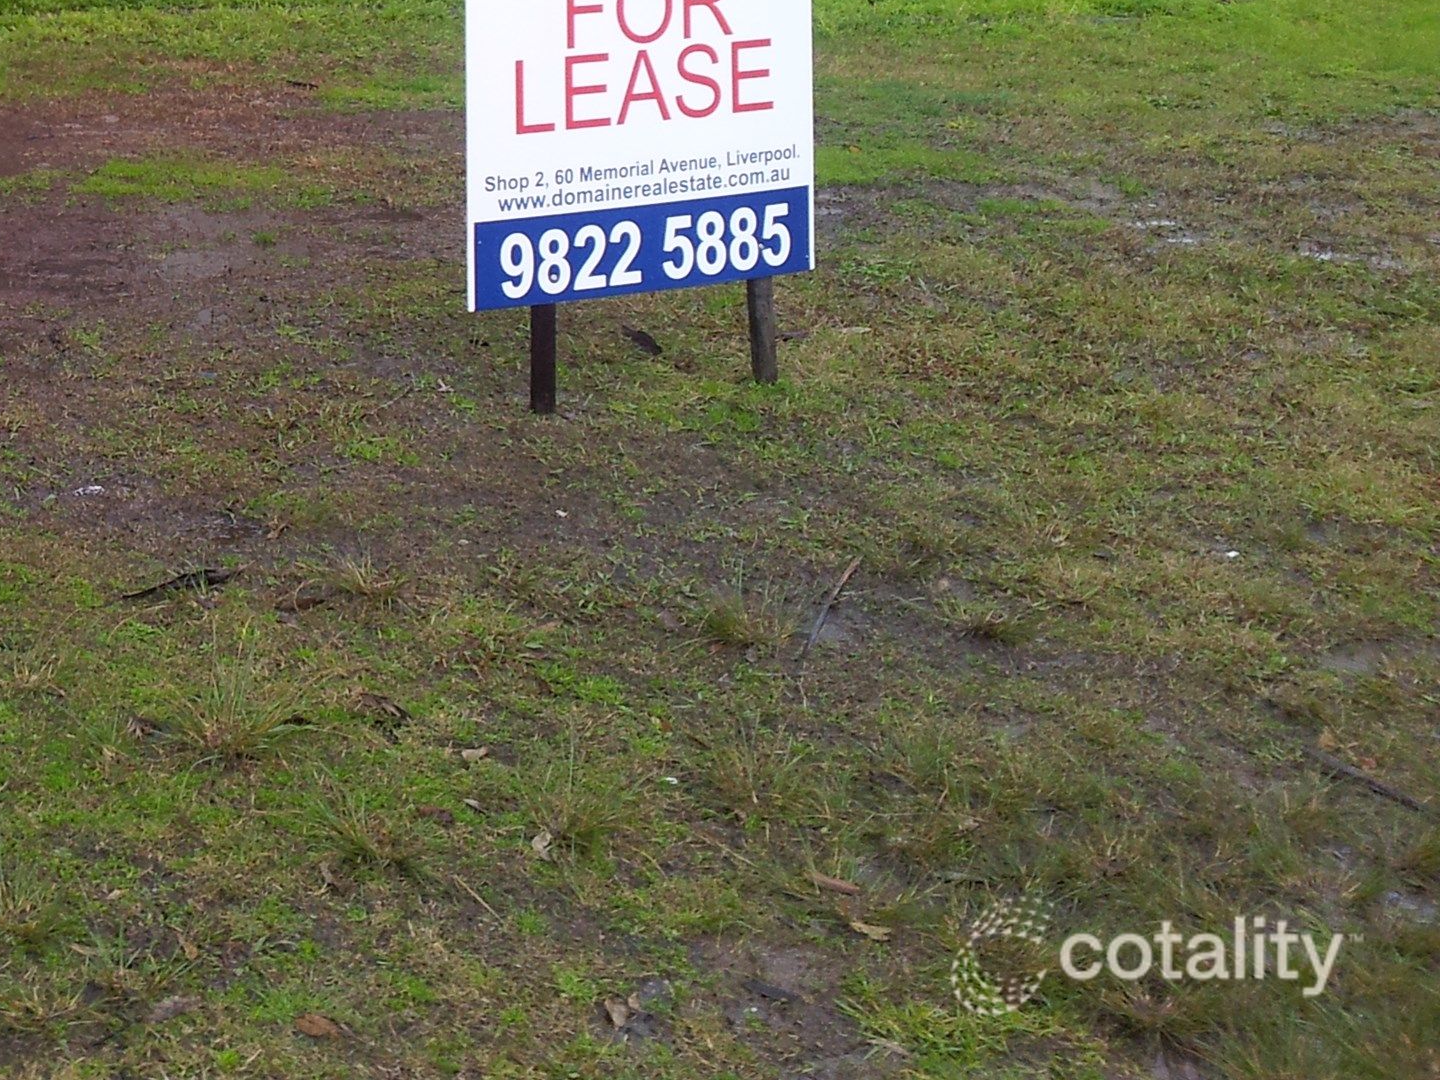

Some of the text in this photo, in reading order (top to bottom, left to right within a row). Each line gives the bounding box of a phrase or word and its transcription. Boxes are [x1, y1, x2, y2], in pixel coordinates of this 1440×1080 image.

[515, 38, 774, 135] LEASE
[484, 143, 801, 193] Shop 2, 60 Memorial Avenue, Liverpool.
[498, 167, 790, 212] www.domainerealestate.com.au
[499, 202, 792, 300] 9822 5885
